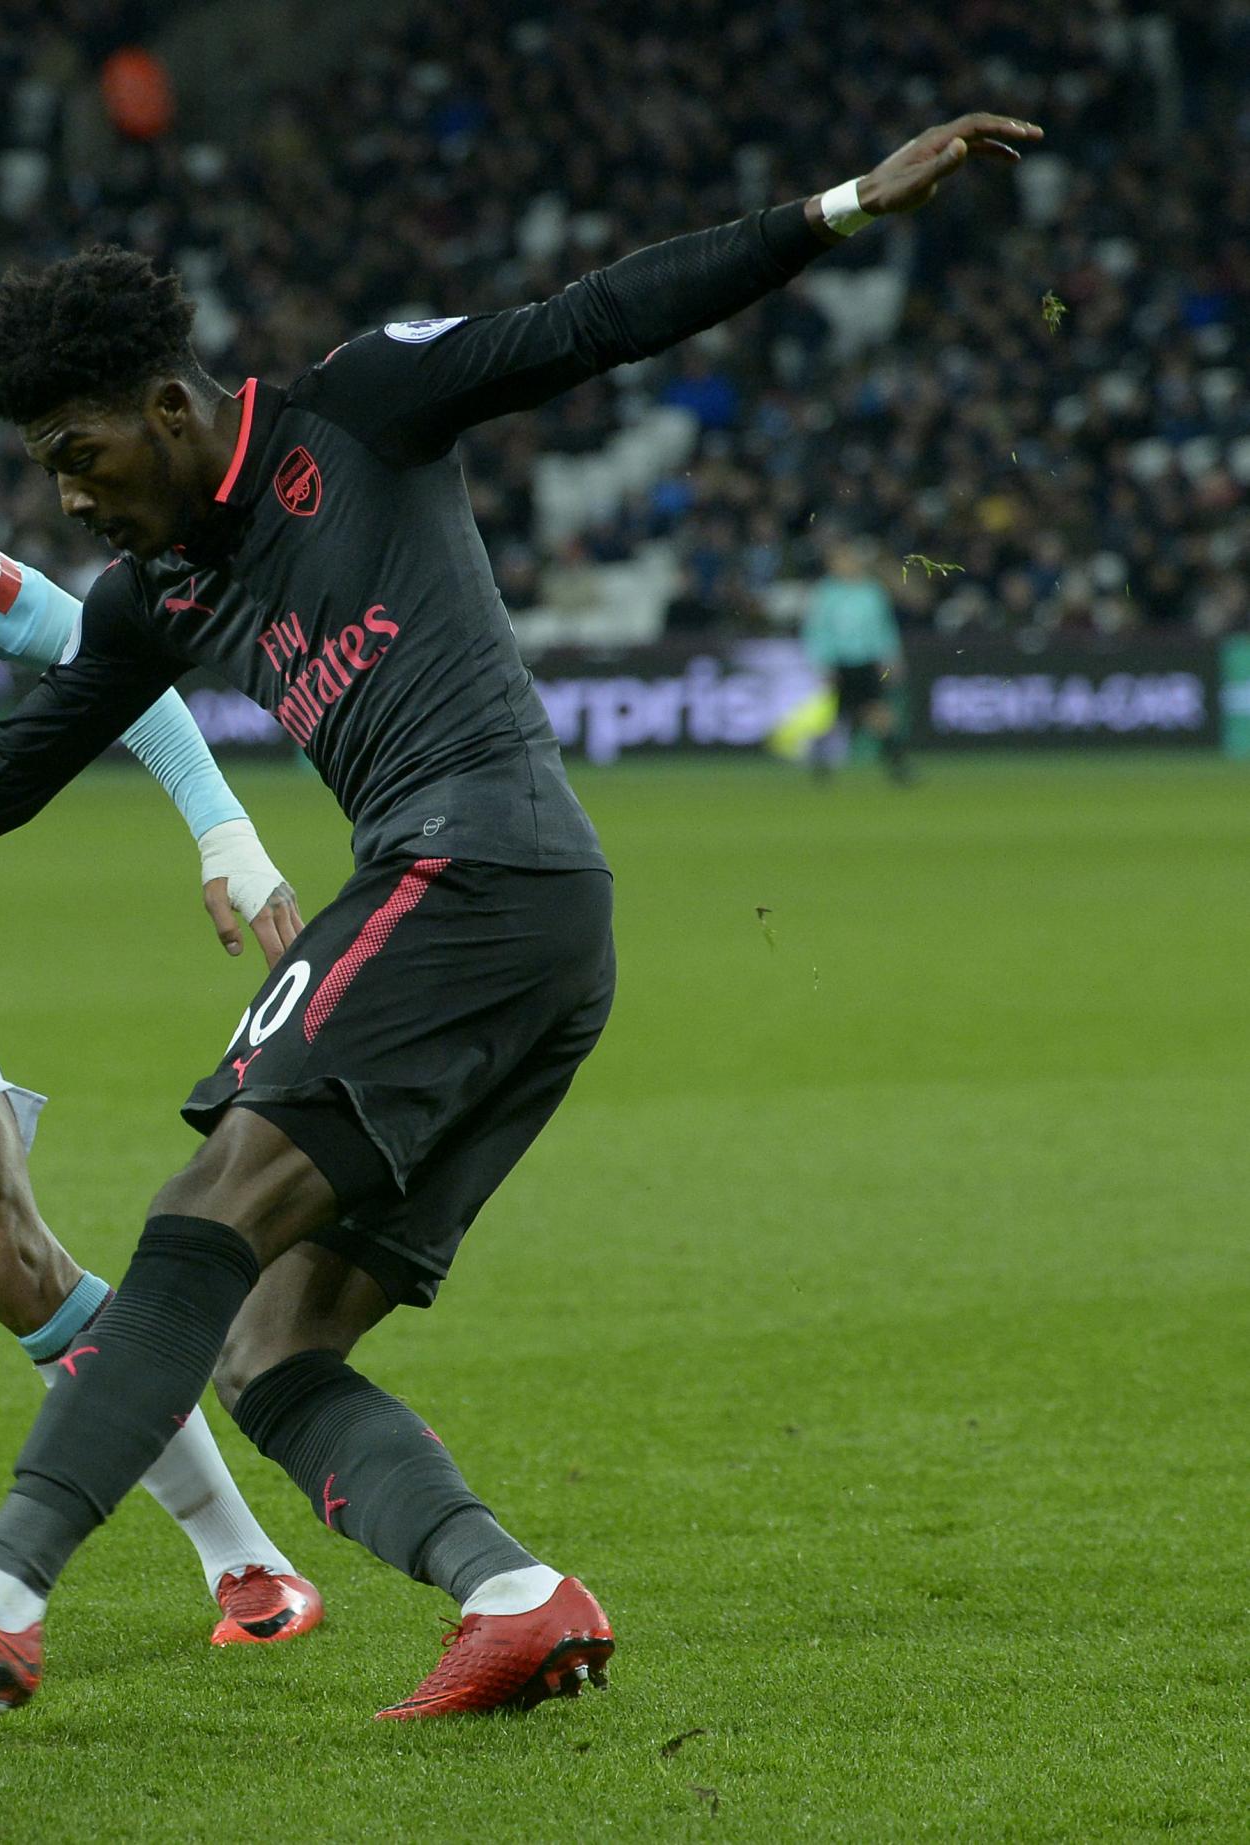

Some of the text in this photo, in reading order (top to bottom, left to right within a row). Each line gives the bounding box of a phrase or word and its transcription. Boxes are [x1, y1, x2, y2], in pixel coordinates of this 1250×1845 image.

[256, 611, 309, 672] Fly
[277, 604, 399, 748] mirates
[223, 959, 311, 1058] 0
